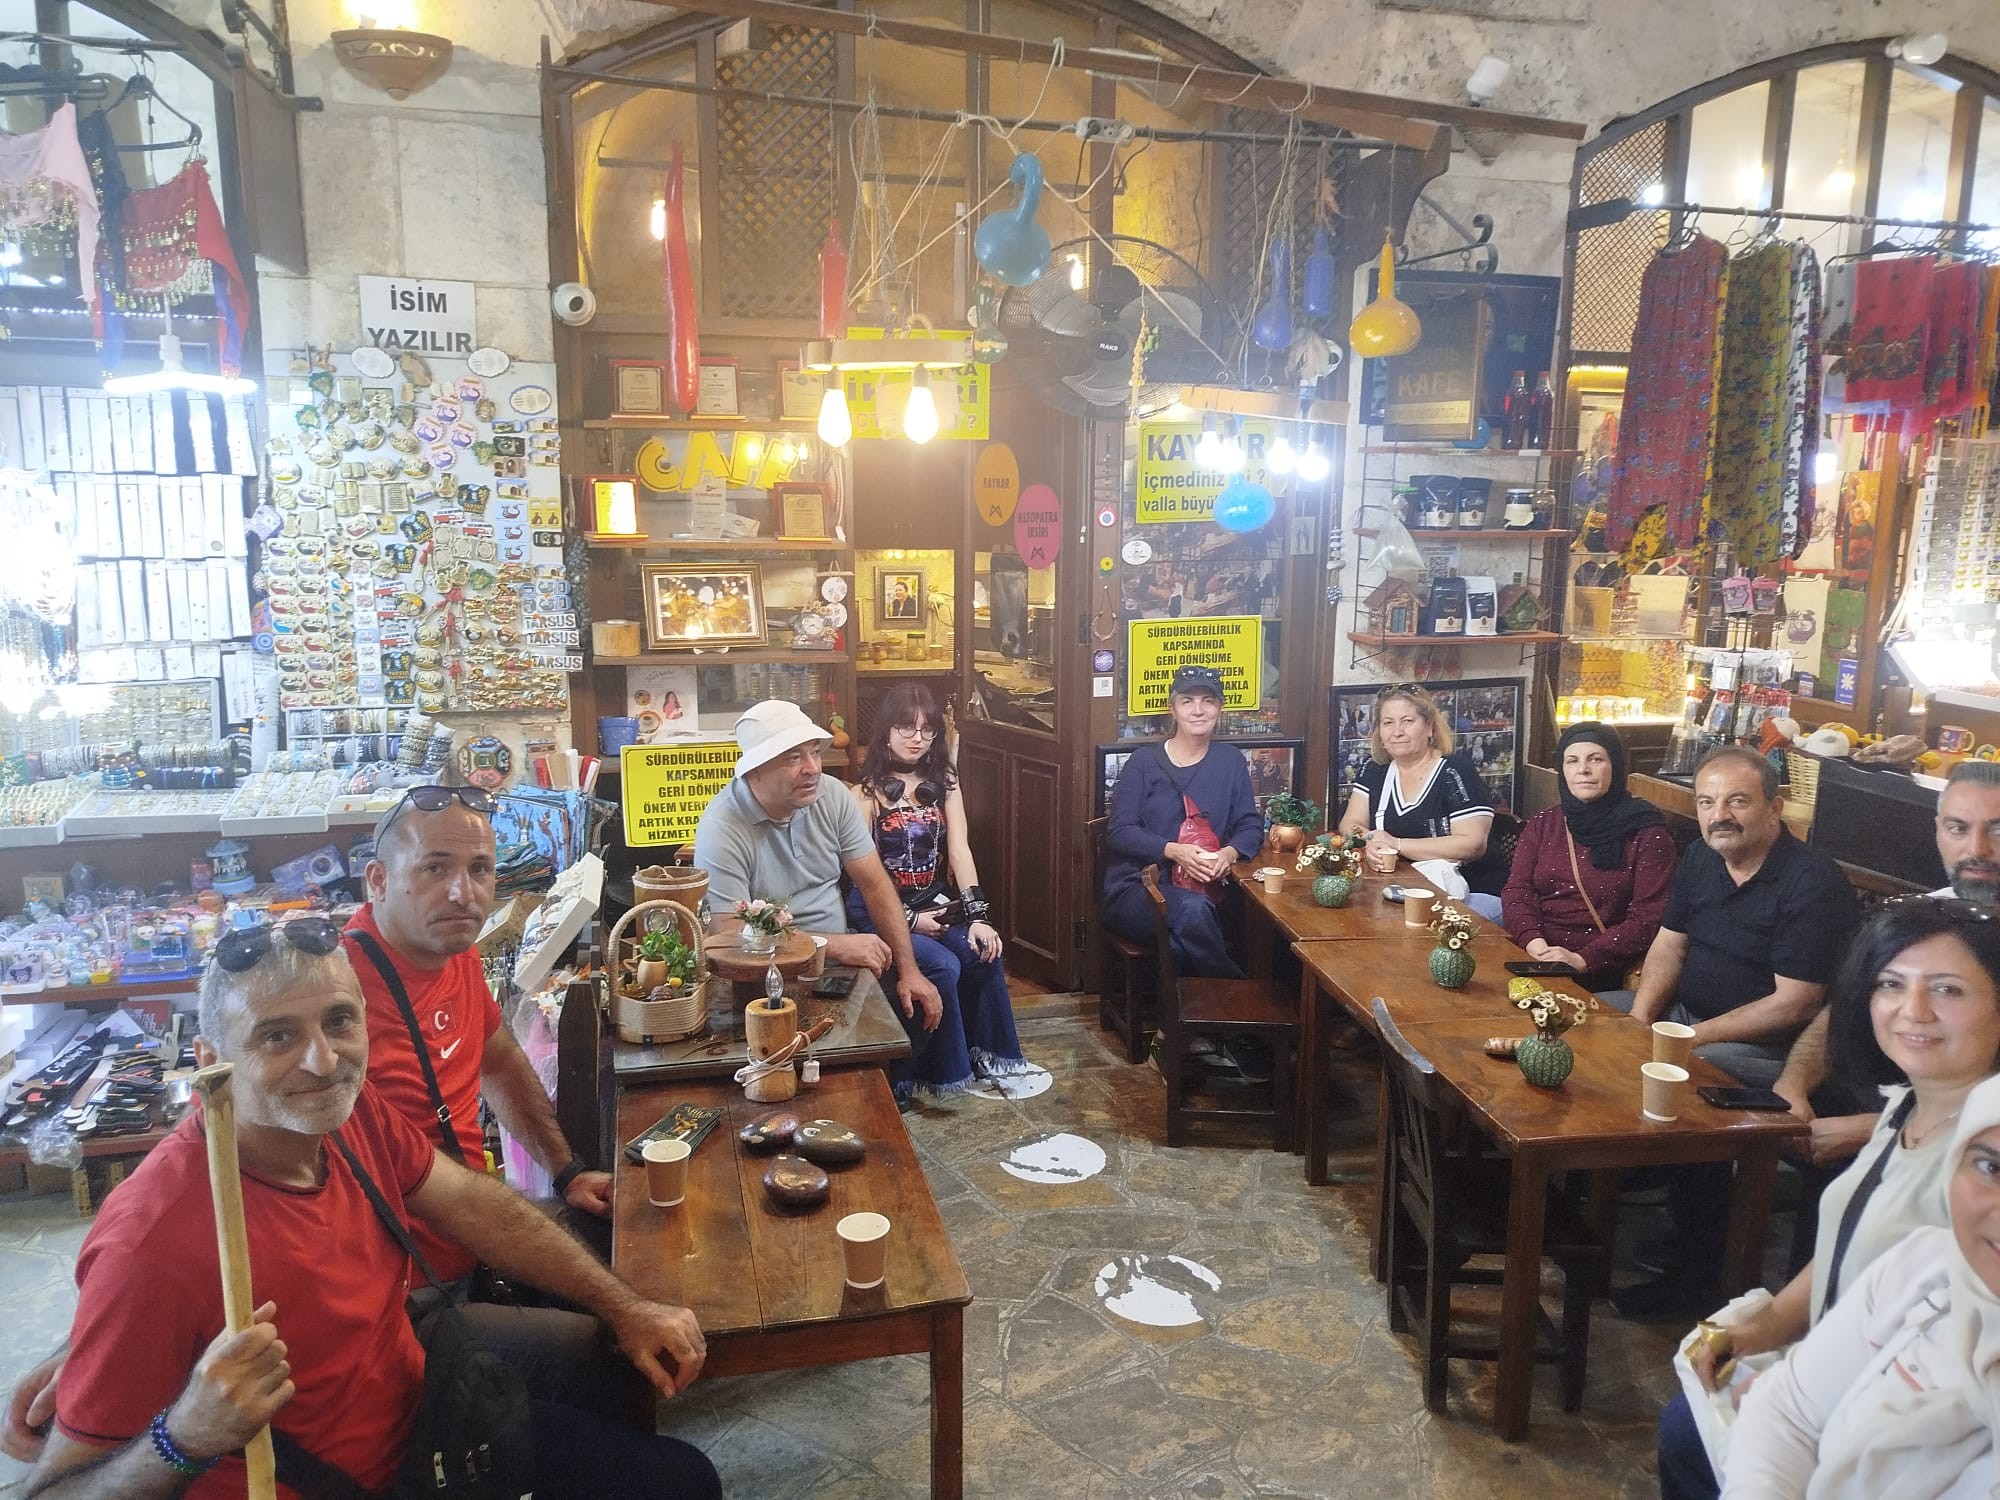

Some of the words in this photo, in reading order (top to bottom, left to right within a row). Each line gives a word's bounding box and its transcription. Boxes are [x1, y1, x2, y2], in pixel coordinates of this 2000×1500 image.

[390, 284, 447, 313] İSİM
[367, 327, 473, 353] YAZILIR
[1144, 470, 1225, 493] içmediniz
[1143, 494, 1176, 512] valla
[1181, 494, 1219, 514] büyü
[1017, 511, 1058, 523] KLEOPATRA
[1147, 623, 1242, 638] SÜRDÜRÜLEBİLİRLİK
[1163, 639, 1225, 651] KAPSAMINDA
[531, 655, 582, 669] TARSUS
[1156, 654, 1177, 666] GERİ
[1179, 652, 1232, 666] DÖNÜŞÜME
[1143, 669, 1169, 681] ÖNEM
[1138, 684, 1166, 695] ARTIK
[1144, 698, 1168, 709] HİZM
[666, 768, 735, 781] KAPSAMIND
[658, 784, 685, 798] GERİ
[643, 802, 677, 814] ÖNEM
[638, 817, 674, 828] ARTIK
[648, 829, 690, 840] HİZMET
